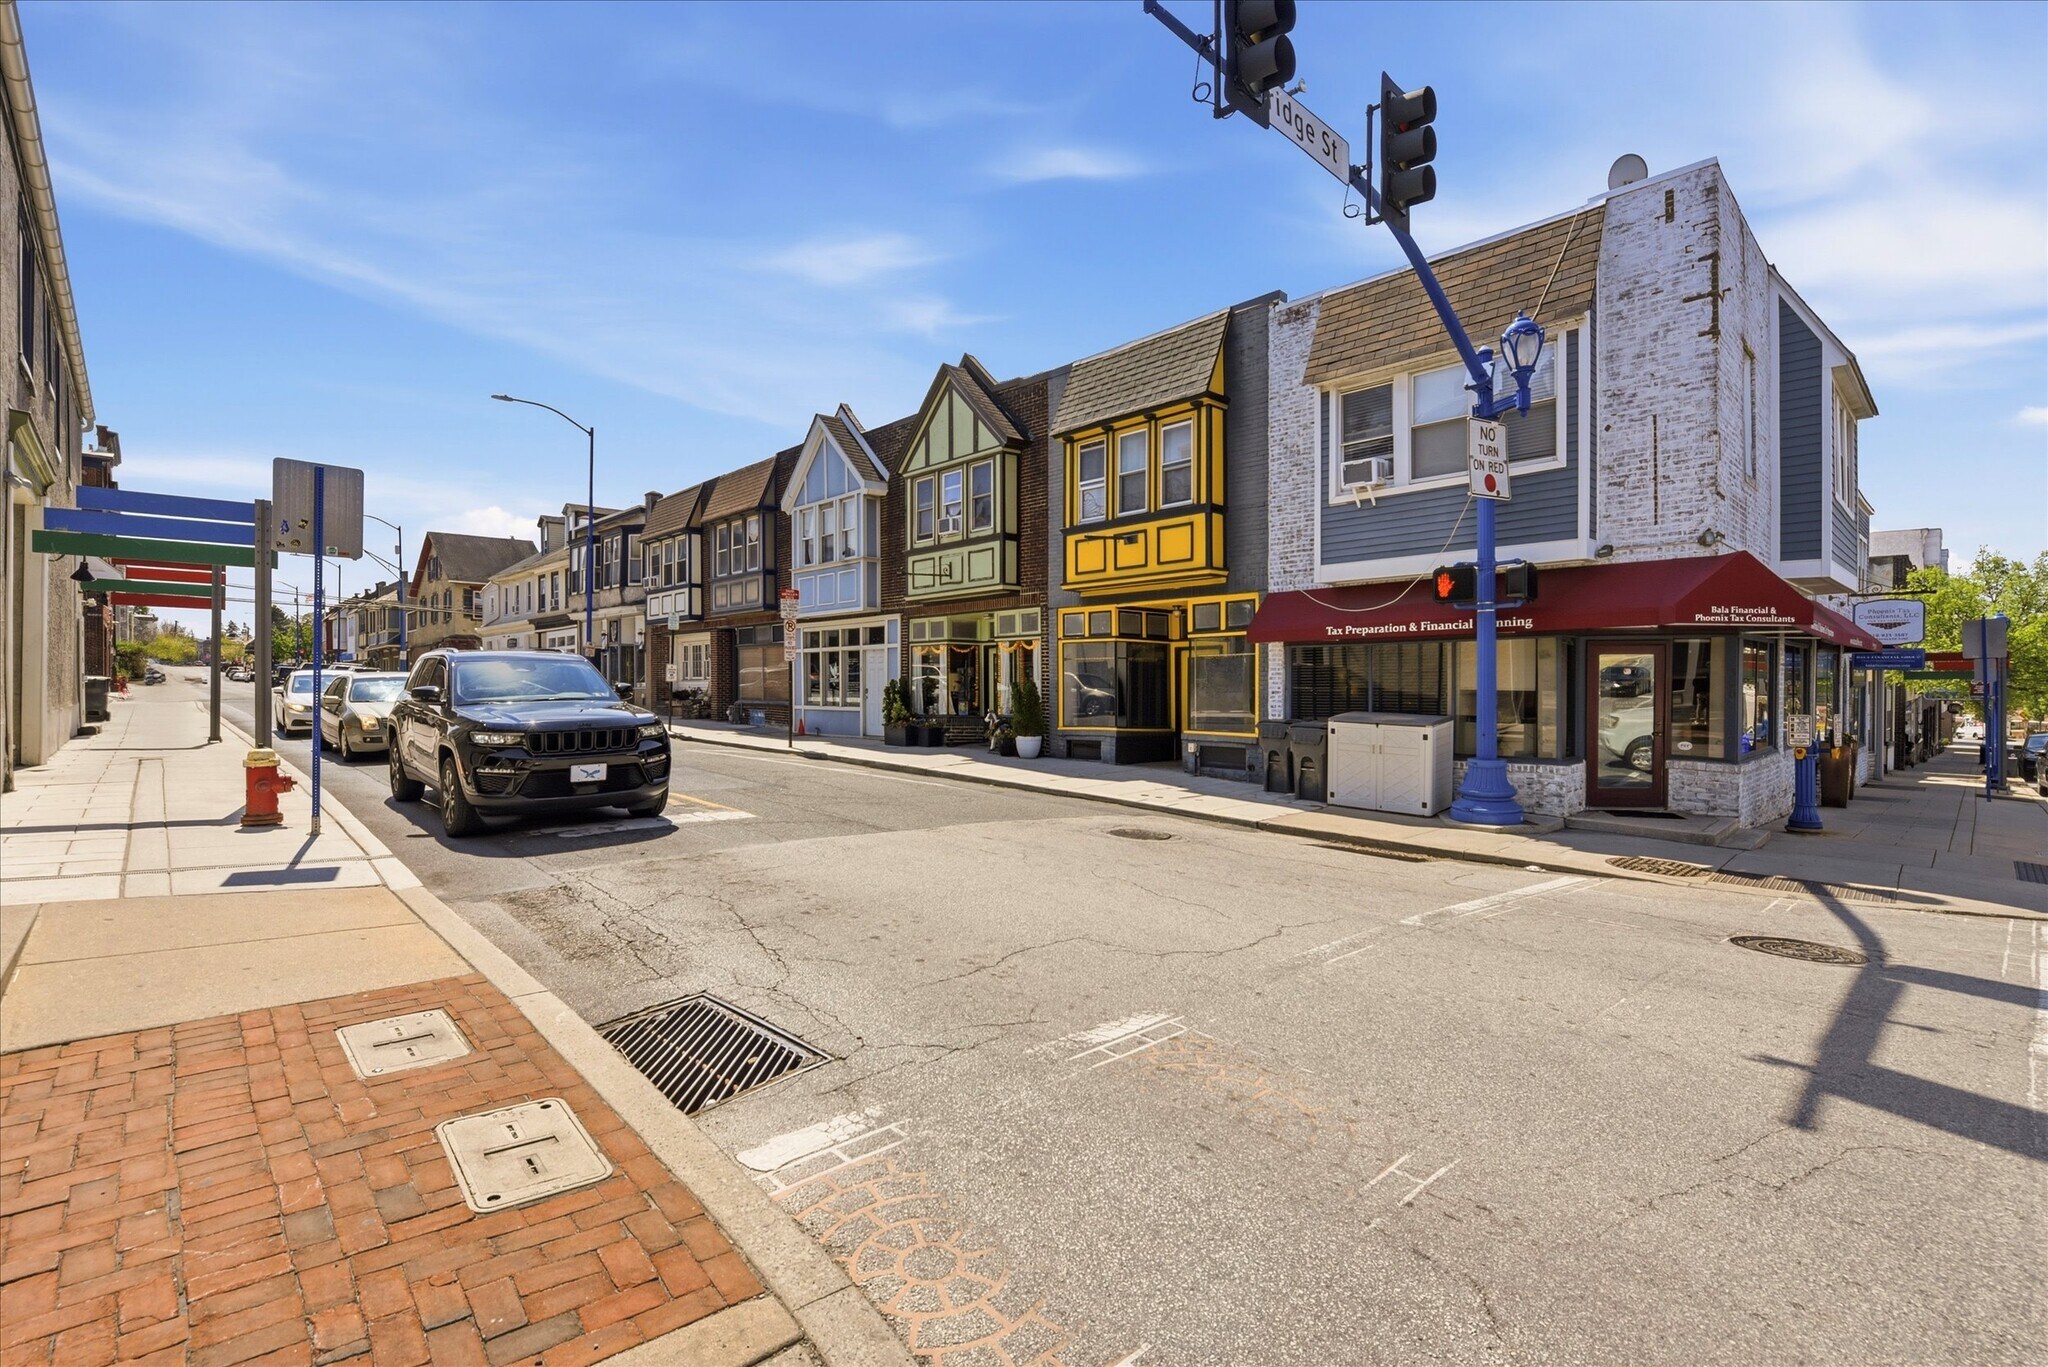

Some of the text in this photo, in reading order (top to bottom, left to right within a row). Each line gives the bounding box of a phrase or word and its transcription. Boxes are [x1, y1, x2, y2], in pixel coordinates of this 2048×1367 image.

[1275, 91, 1338, 164] idge St
[1480, 426, 1496, 442] NO
[1478, 444, 1499, 458] TURN
[1473, 459, 1504, 474] ON RED
[1711, 606, 1729, 614] Bala
[1731, 606, 1768, 614] Financial
[1695, 614, 1795, 623] Phoenix Tax Consultants
[1326, 617, 1533, 636] Tax Preparation & Financial nning
